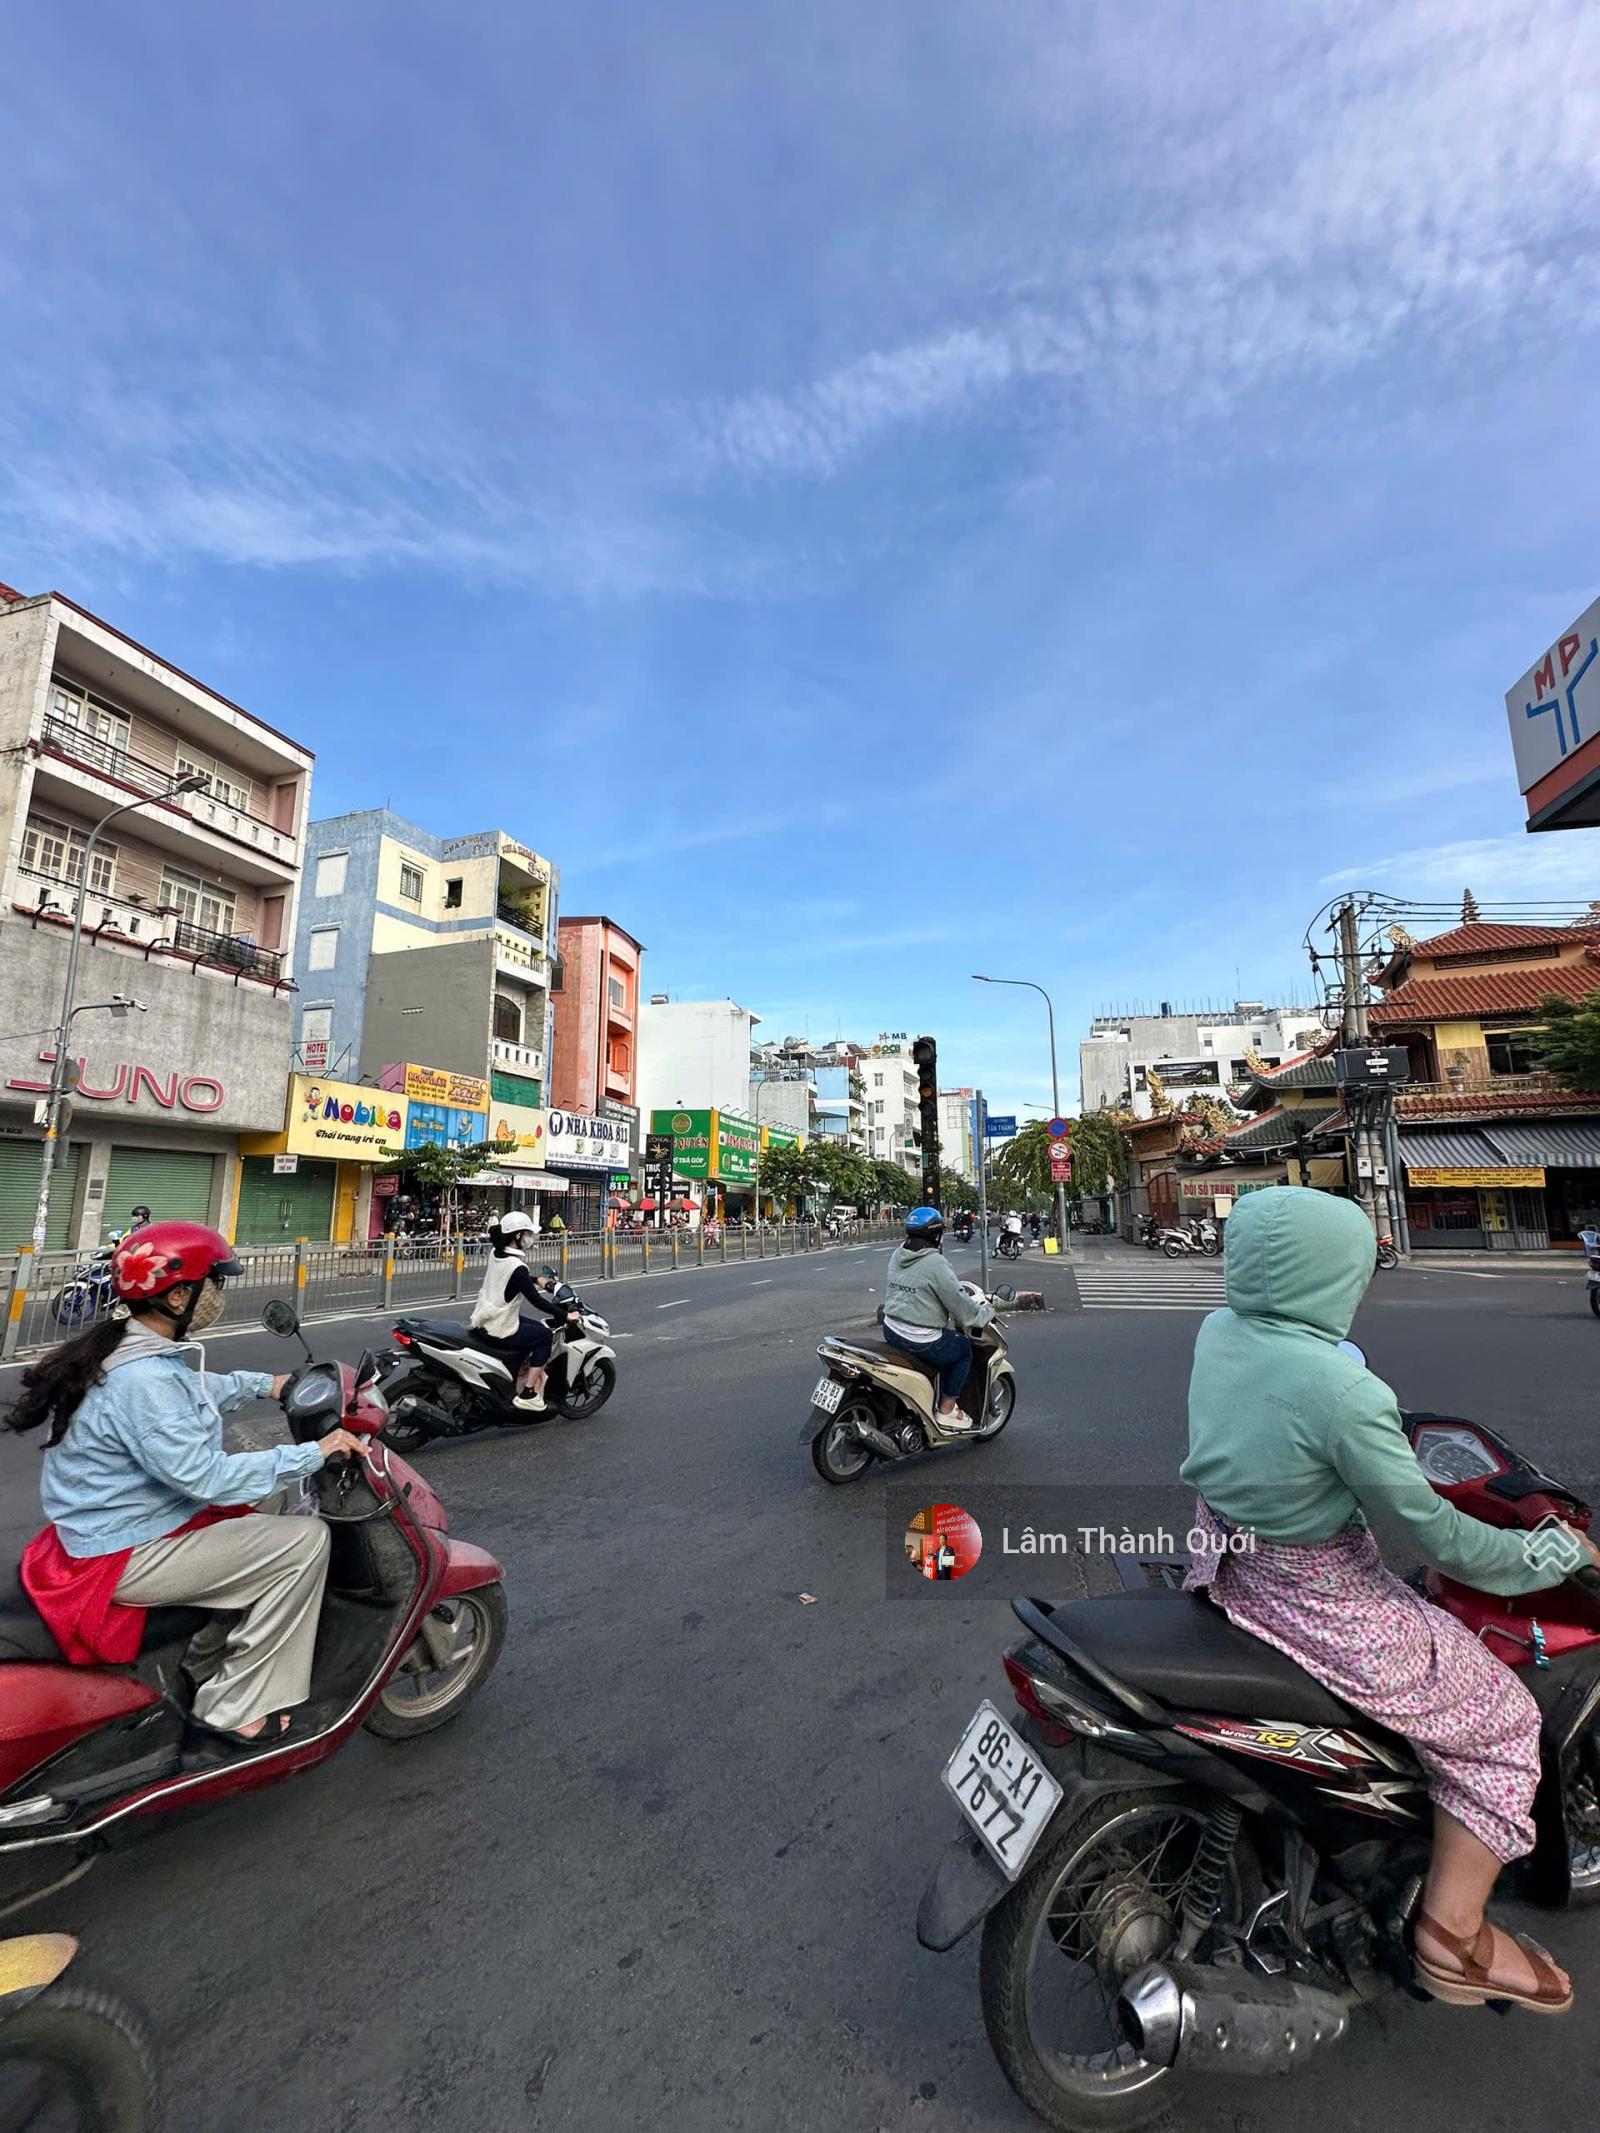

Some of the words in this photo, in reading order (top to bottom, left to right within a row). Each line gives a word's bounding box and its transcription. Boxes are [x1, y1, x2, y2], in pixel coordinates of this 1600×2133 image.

[306, 1043, 327, 1053] HOTEL
[323, 1096, 402, 1131] Nobita
[337, 1132, 361, 1144] trang
[565, 1117, 588, 1138] NHA
[589, 1121, 614, 1141] KHOA
[615, 1126, 628, 1143] 811
[978, 1719, 1043, 1810] 86-X1
